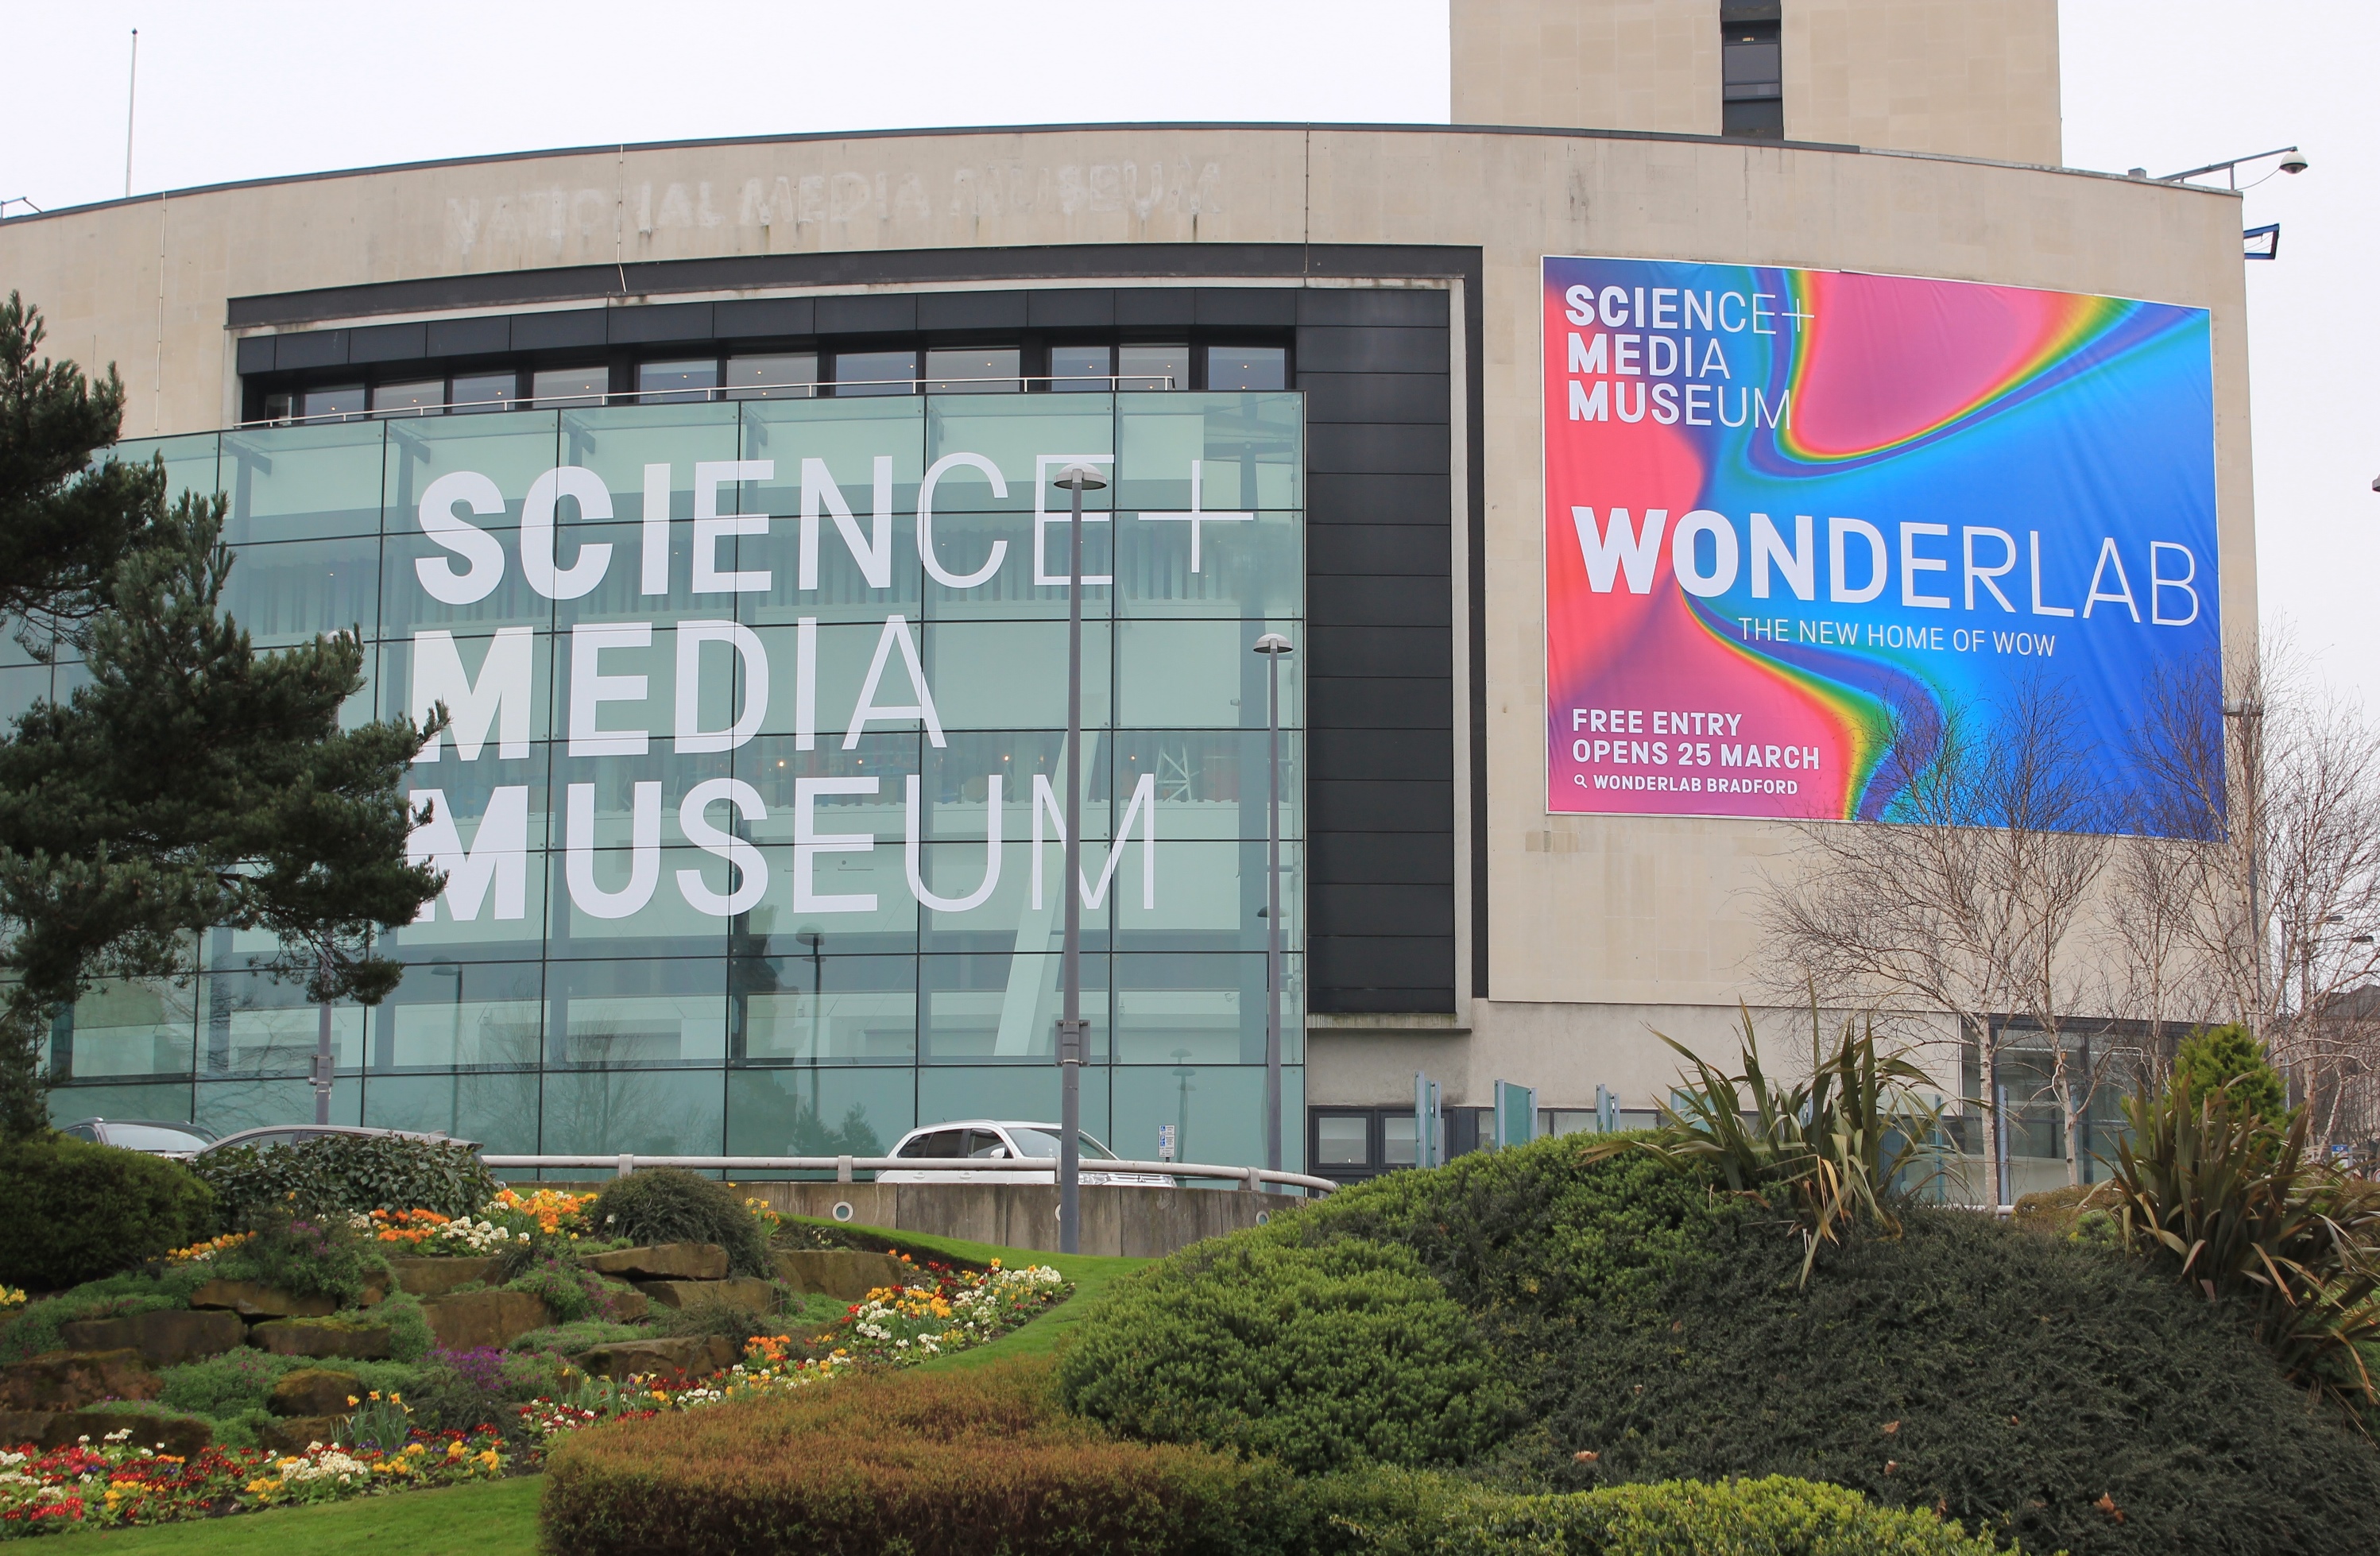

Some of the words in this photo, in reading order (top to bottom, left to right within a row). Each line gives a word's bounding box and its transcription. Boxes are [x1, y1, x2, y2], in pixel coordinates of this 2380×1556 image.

[739, 172, 931, 225] MEDIA
[1568, 332, 1731, 379] MEDIA
[1569, 380, 1790, 430] MUSEUM
[1570, 505, 2199, 626] WONDERLAB
[1738, 617, 1789, 642] THE
[1799, 620, 1859, 646] NEW
[1867, 624, 1944, 650] HOME
[1952, 629, 1985, 652] OF
[1992, 631, 2055, 657] WOW
[411, 615, 947, 763] MEDIA
[1573, 708, 1643, 733] FREE
[1653, 711, 1742, 736] ENTRY
[1573, 739, 1668, 765] OPENS
[1678, 742, 1711, 766] 25
[1720, 744, 1819, 770] MARCH
[1593, 774, 1701, 792] WONDERLAB
[1707, 778, 1798, 795] BRADFORD
[408, 773, 1155, 923] MUSEUM
